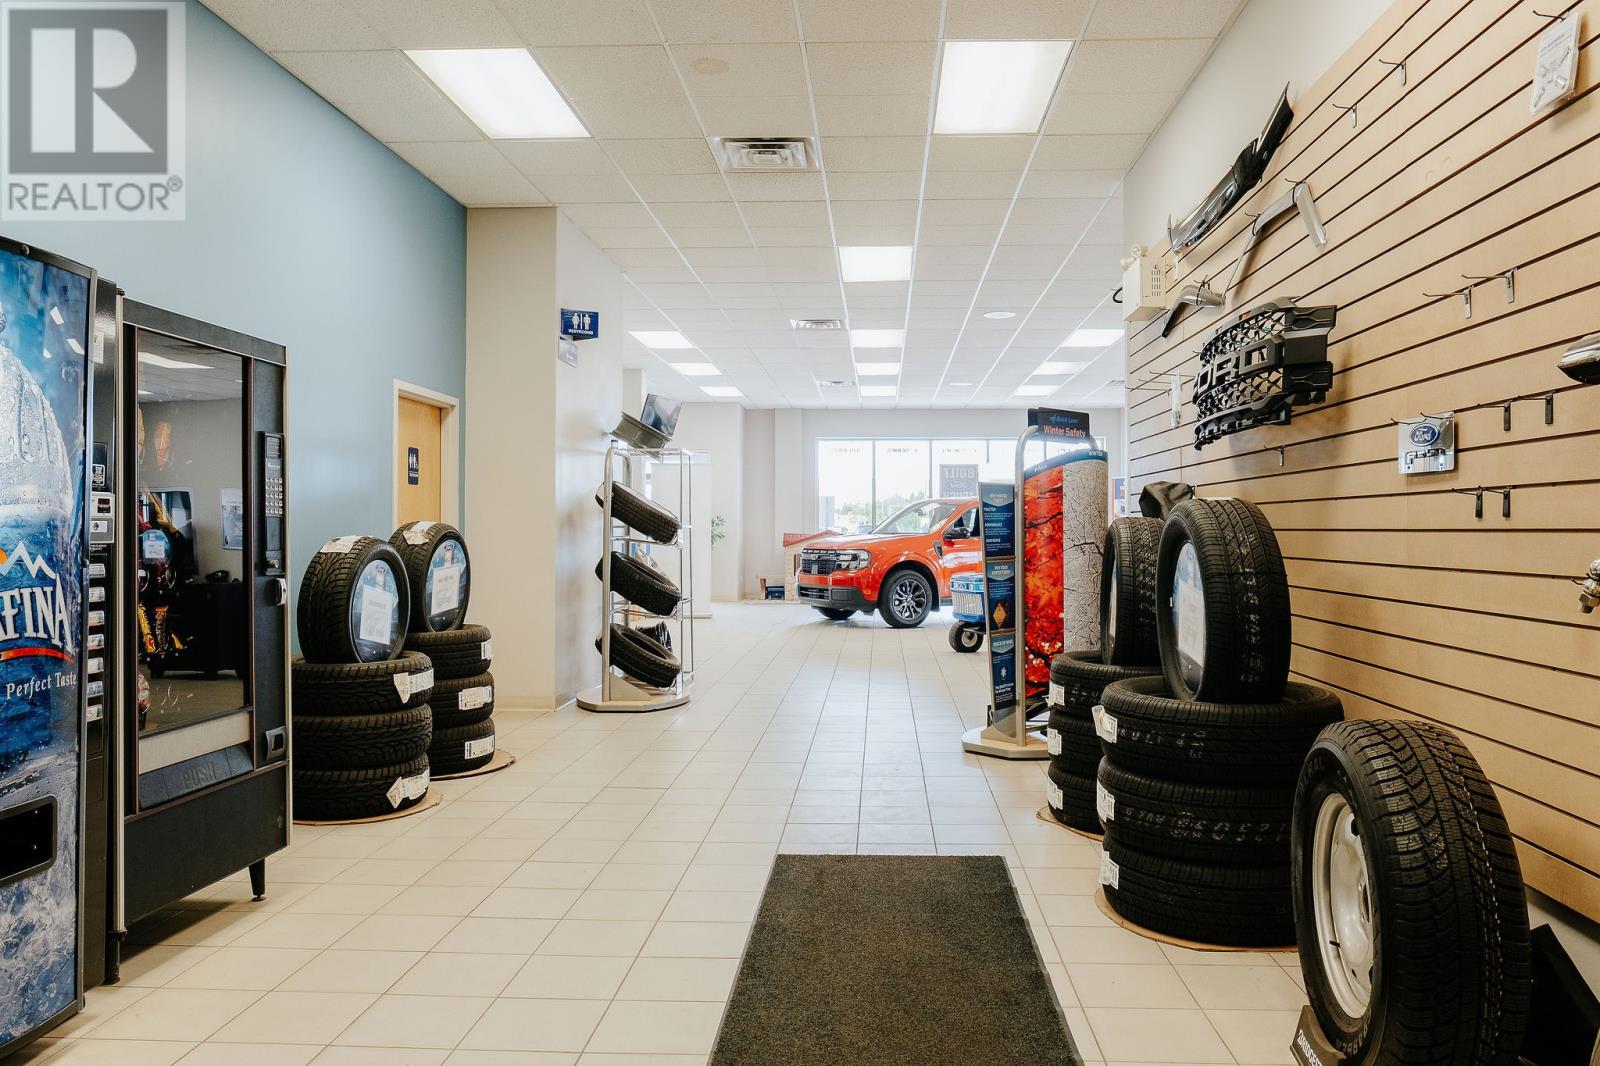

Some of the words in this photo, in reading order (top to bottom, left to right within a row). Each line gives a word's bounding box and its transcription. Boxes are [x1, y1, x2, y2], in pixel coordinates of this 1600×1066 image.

[1044, 424, 1065, 436] Winter
[1065, 427, 1086, 439] Safety
[6, 673, 52, 700] Perfect
[54, 671, 77, 689] Taste
